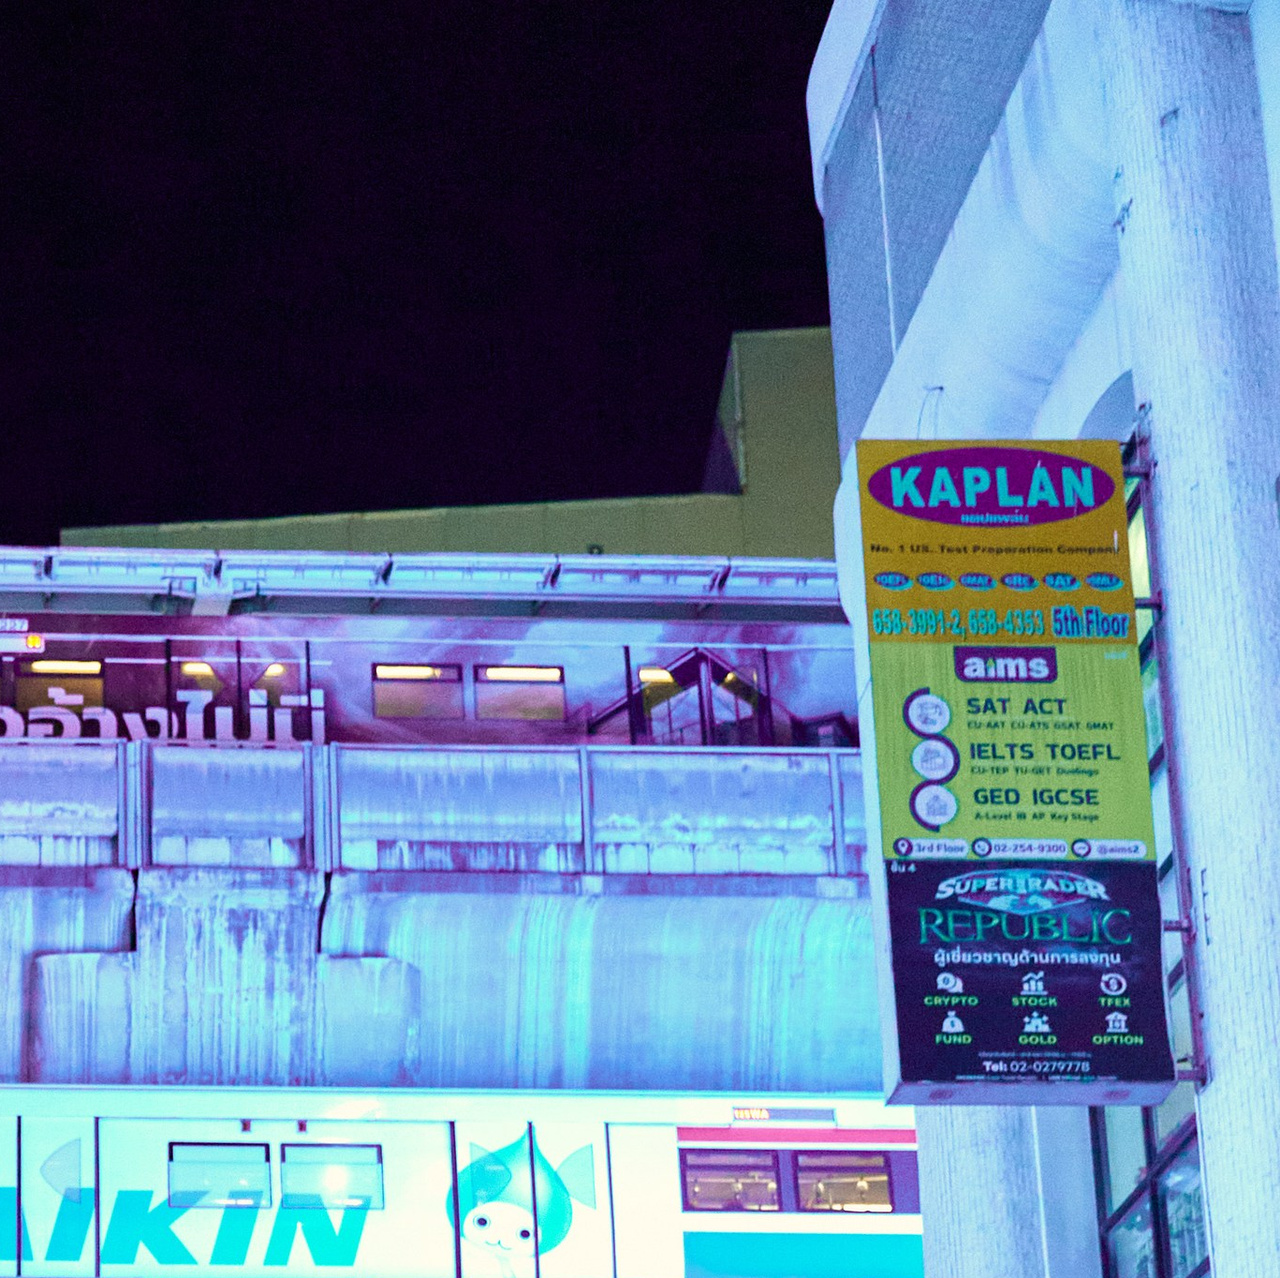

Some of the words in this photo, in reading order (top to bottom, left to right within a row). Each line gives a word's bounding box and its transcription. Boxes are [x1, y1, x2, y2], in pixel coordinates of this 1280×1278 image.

[888, 467, 1096, 507] KAPLAN
[940, 545, 968, 554] Test
[973, 545, 1053, 556] Preparation
[1052, 604, 1082, 638] 5th
[1084, 605, 1130, 639] Floor
[963, 656, 1050, 679] aims
[966, 697, 1010, 715] SAT
[1023, 697, 1067, 715] ACT
[970, 743, 1034, 760] IELTS
[1045, 743, 1122, 760] TOEFL
[973, 788, 1020, 806] GED
[1032, 788, 1100, 806] IGCSE
[915, 843, 933, 853] 3rd
[936, 843, 966, 853] Floor
[918, 908, 1133, 945] REPUBLIC
[923, 996, 979, 1007] CRYPTO
[1011, 996, 1058, 1008] STOCK
[1097, 996, 1131, 1008] TFEX
[934, 1034, 972, 1045] FUND
[1018, 1034, 1057, 1046] GOLD
[1092, 1034, 1144, 1046] OPTION
